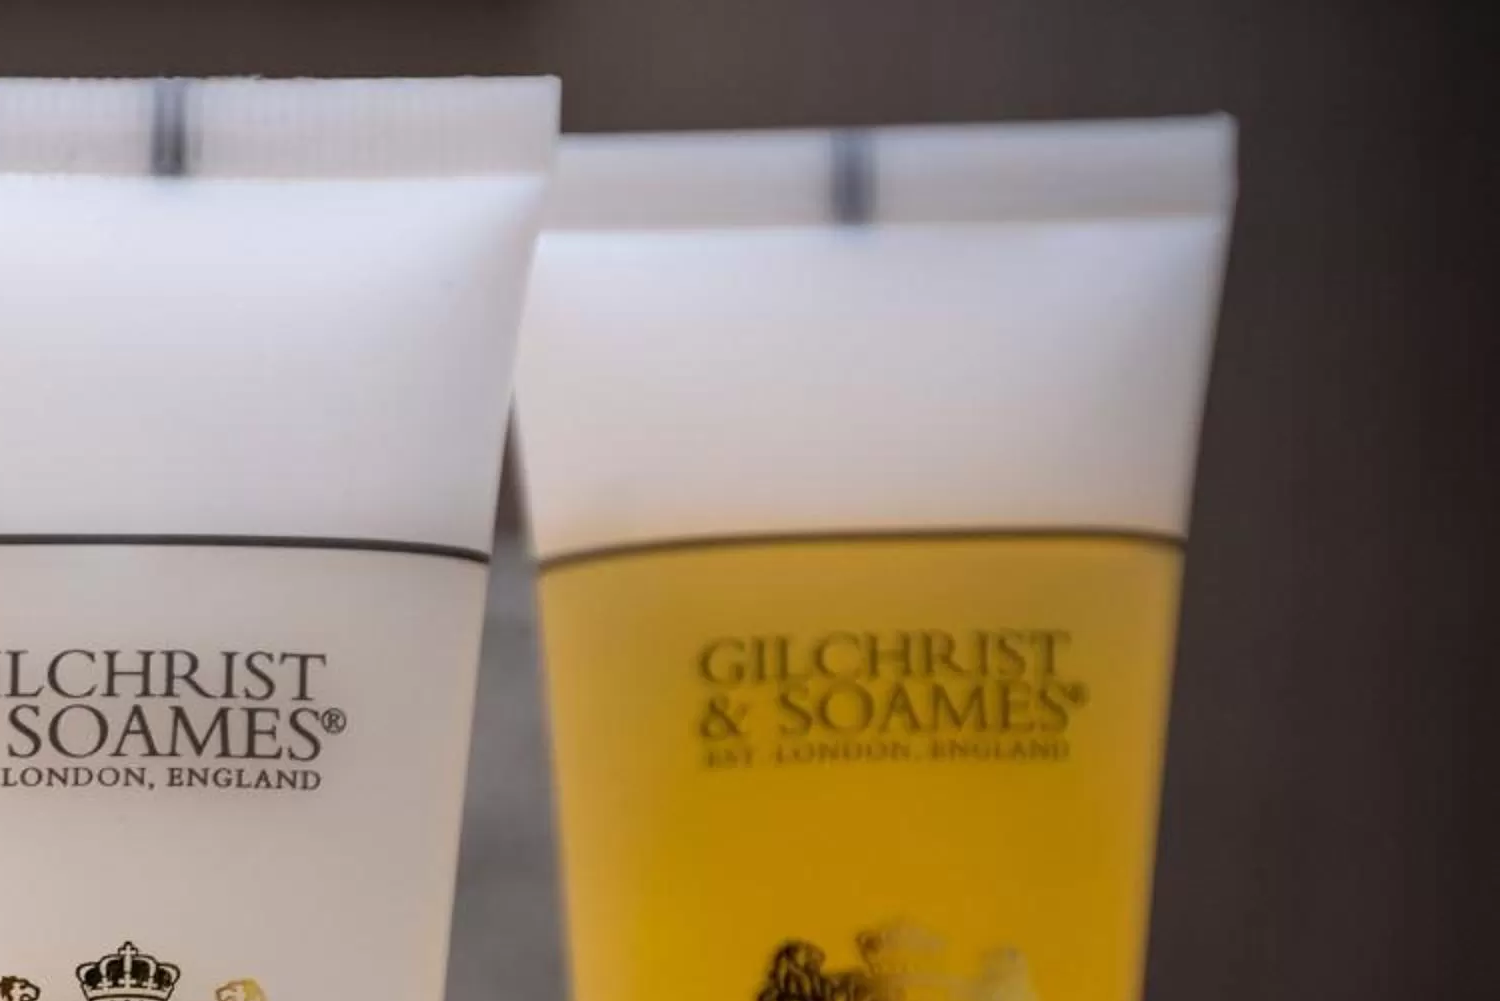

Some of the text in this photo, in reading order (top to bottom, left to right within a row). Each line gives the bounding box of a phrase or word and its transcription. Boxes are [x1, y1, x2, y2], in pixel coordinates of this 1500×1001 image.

[699, 630, 1071, 685] GILCHRIST
[699, 693, 748, 740] &
[1, 767, 155, 790] LONDON,
[166, 768, 321, 790] ENGLAND
